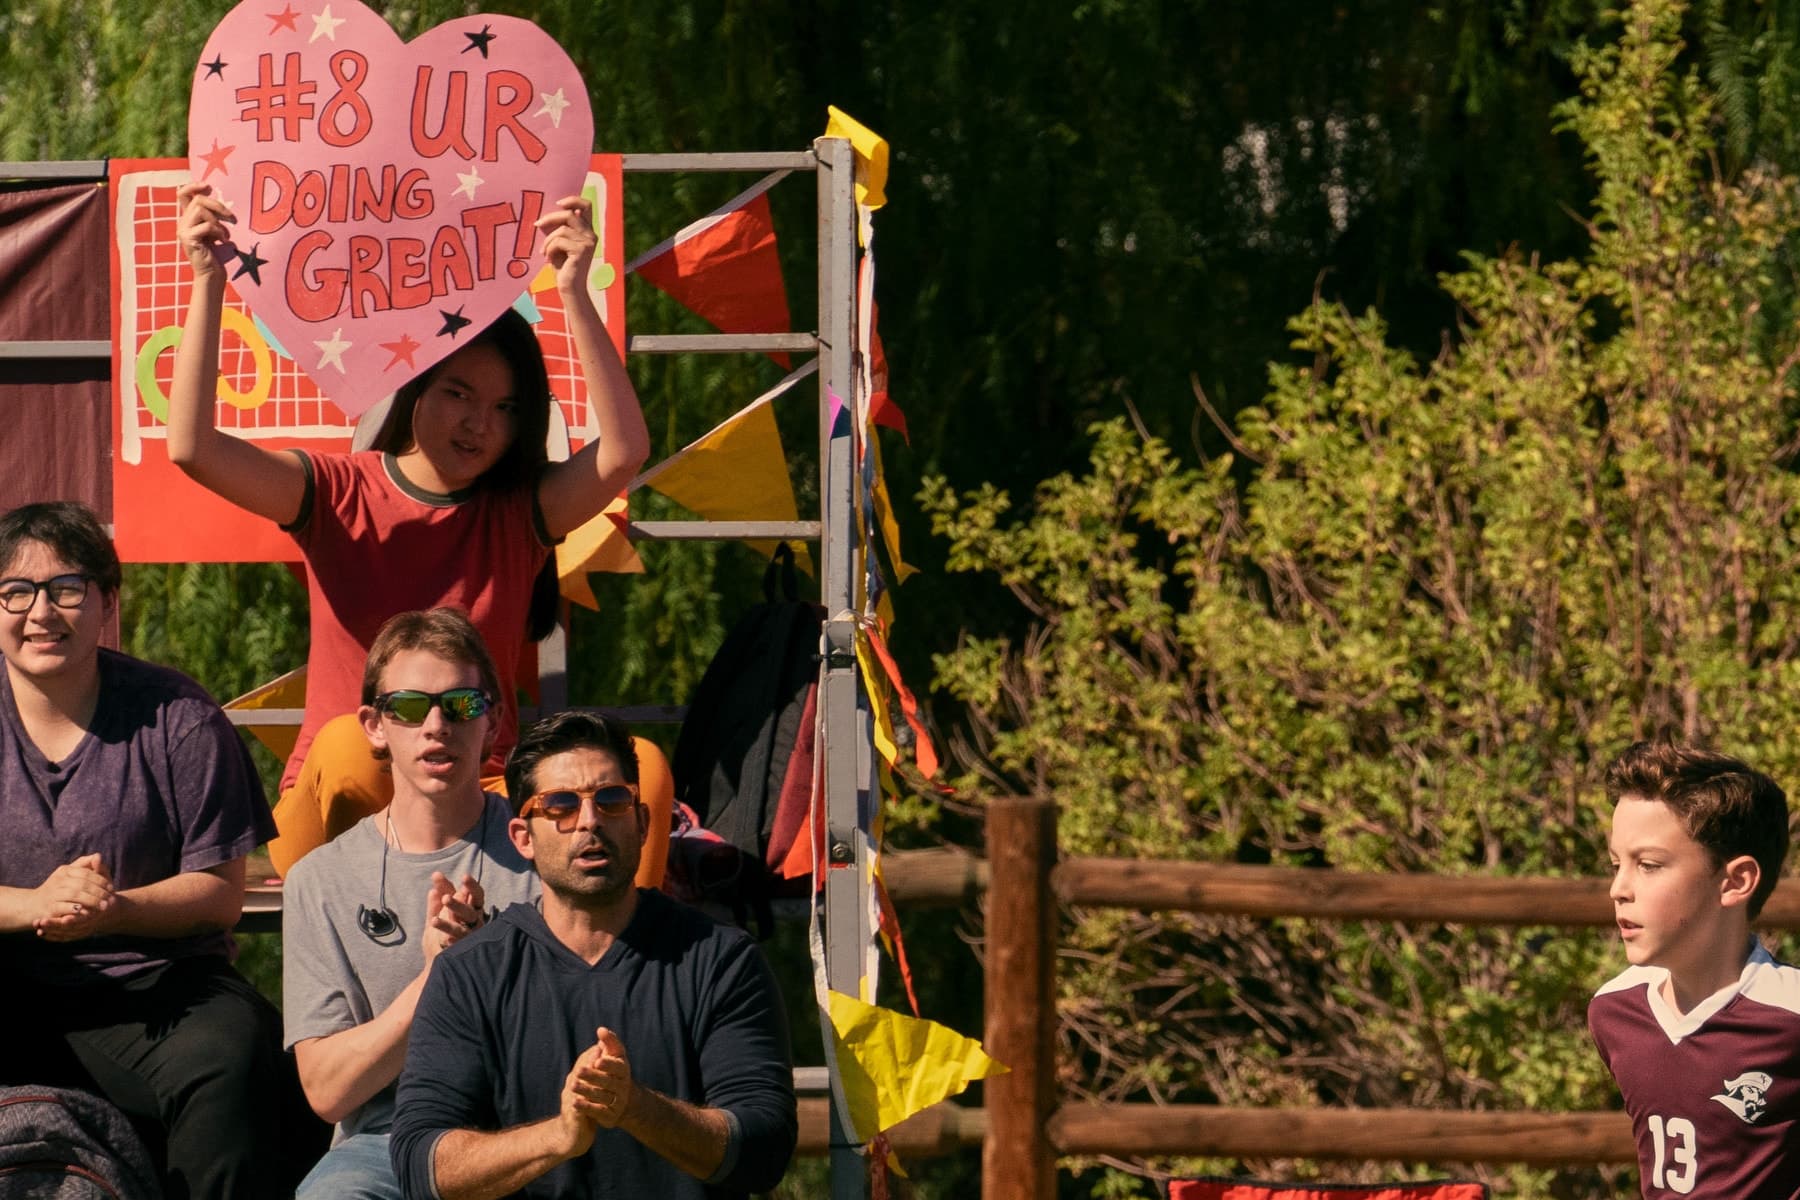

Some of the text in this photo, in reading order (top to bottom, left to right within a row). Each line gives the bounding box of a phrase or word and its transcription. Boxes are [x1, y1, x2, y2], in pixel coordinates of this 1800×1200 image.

[234, 49, 548, 167] #8 UR
[250, 160, 435, 235] DOING
[285, 190, 545, 323] GREAT!
[1648, 1115, 1698, 1194] 13
